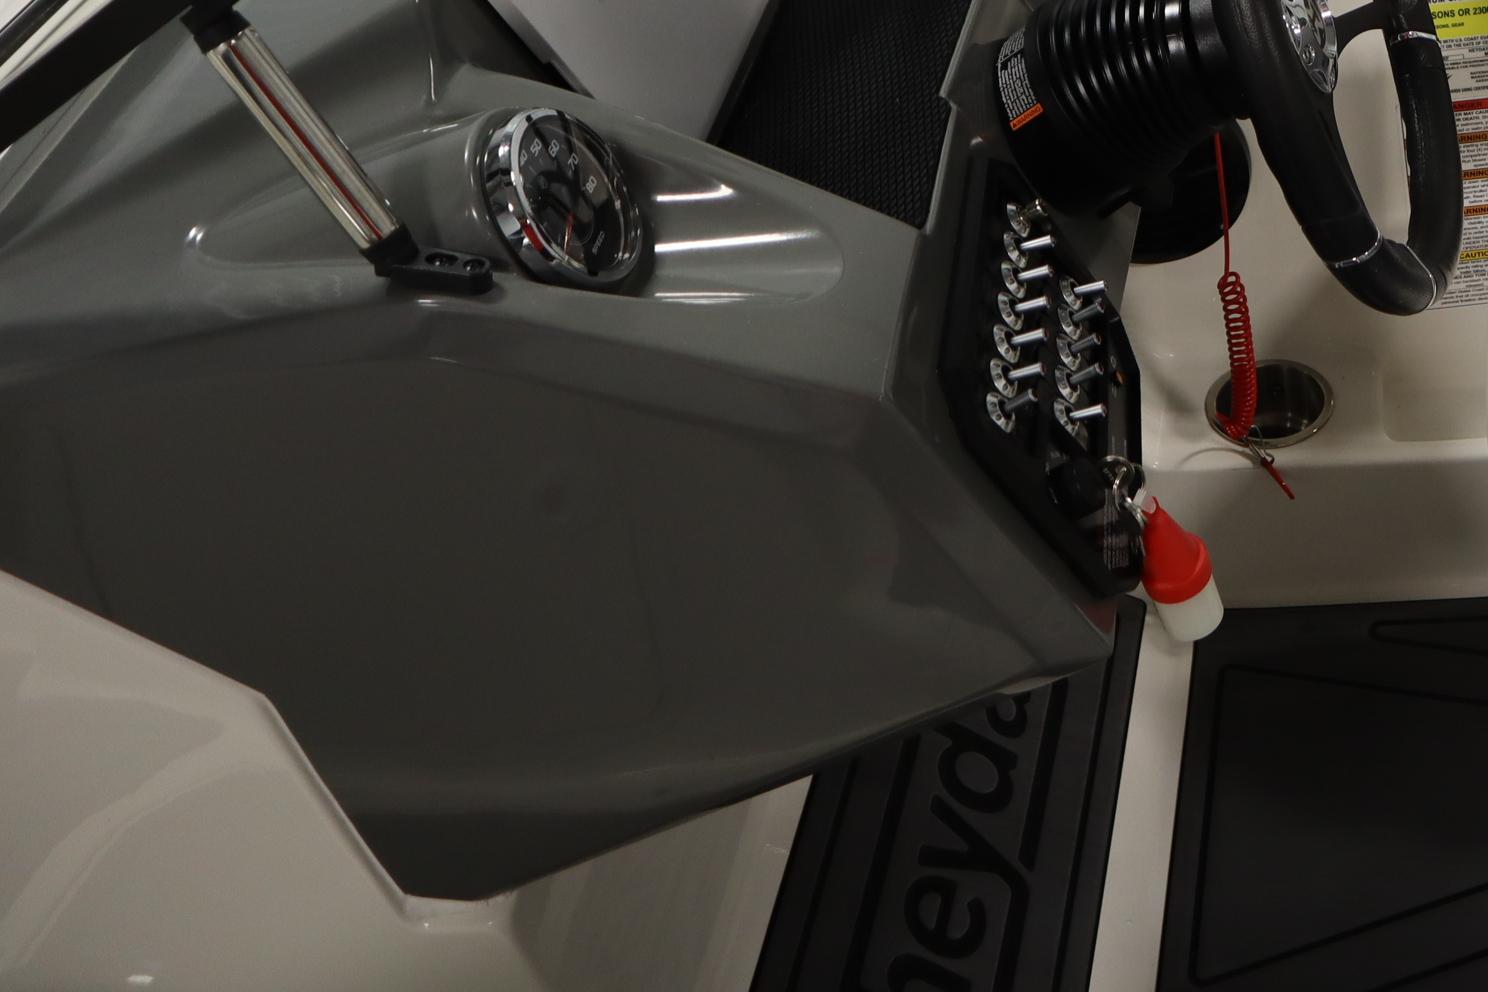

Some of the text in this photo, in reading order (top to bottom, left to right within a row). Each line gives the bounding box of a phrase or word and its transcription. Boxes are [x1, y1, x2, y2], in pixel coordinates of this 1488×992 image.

[1432, 10, 1455, 19] SONS
[1458, 8, 1470, 17] OR
[530, 138, 542, 157] 50
[548, 139, 560, 158] 60
[568, 153, 579, 171] 70
[586, 176, 598, 194] 80
